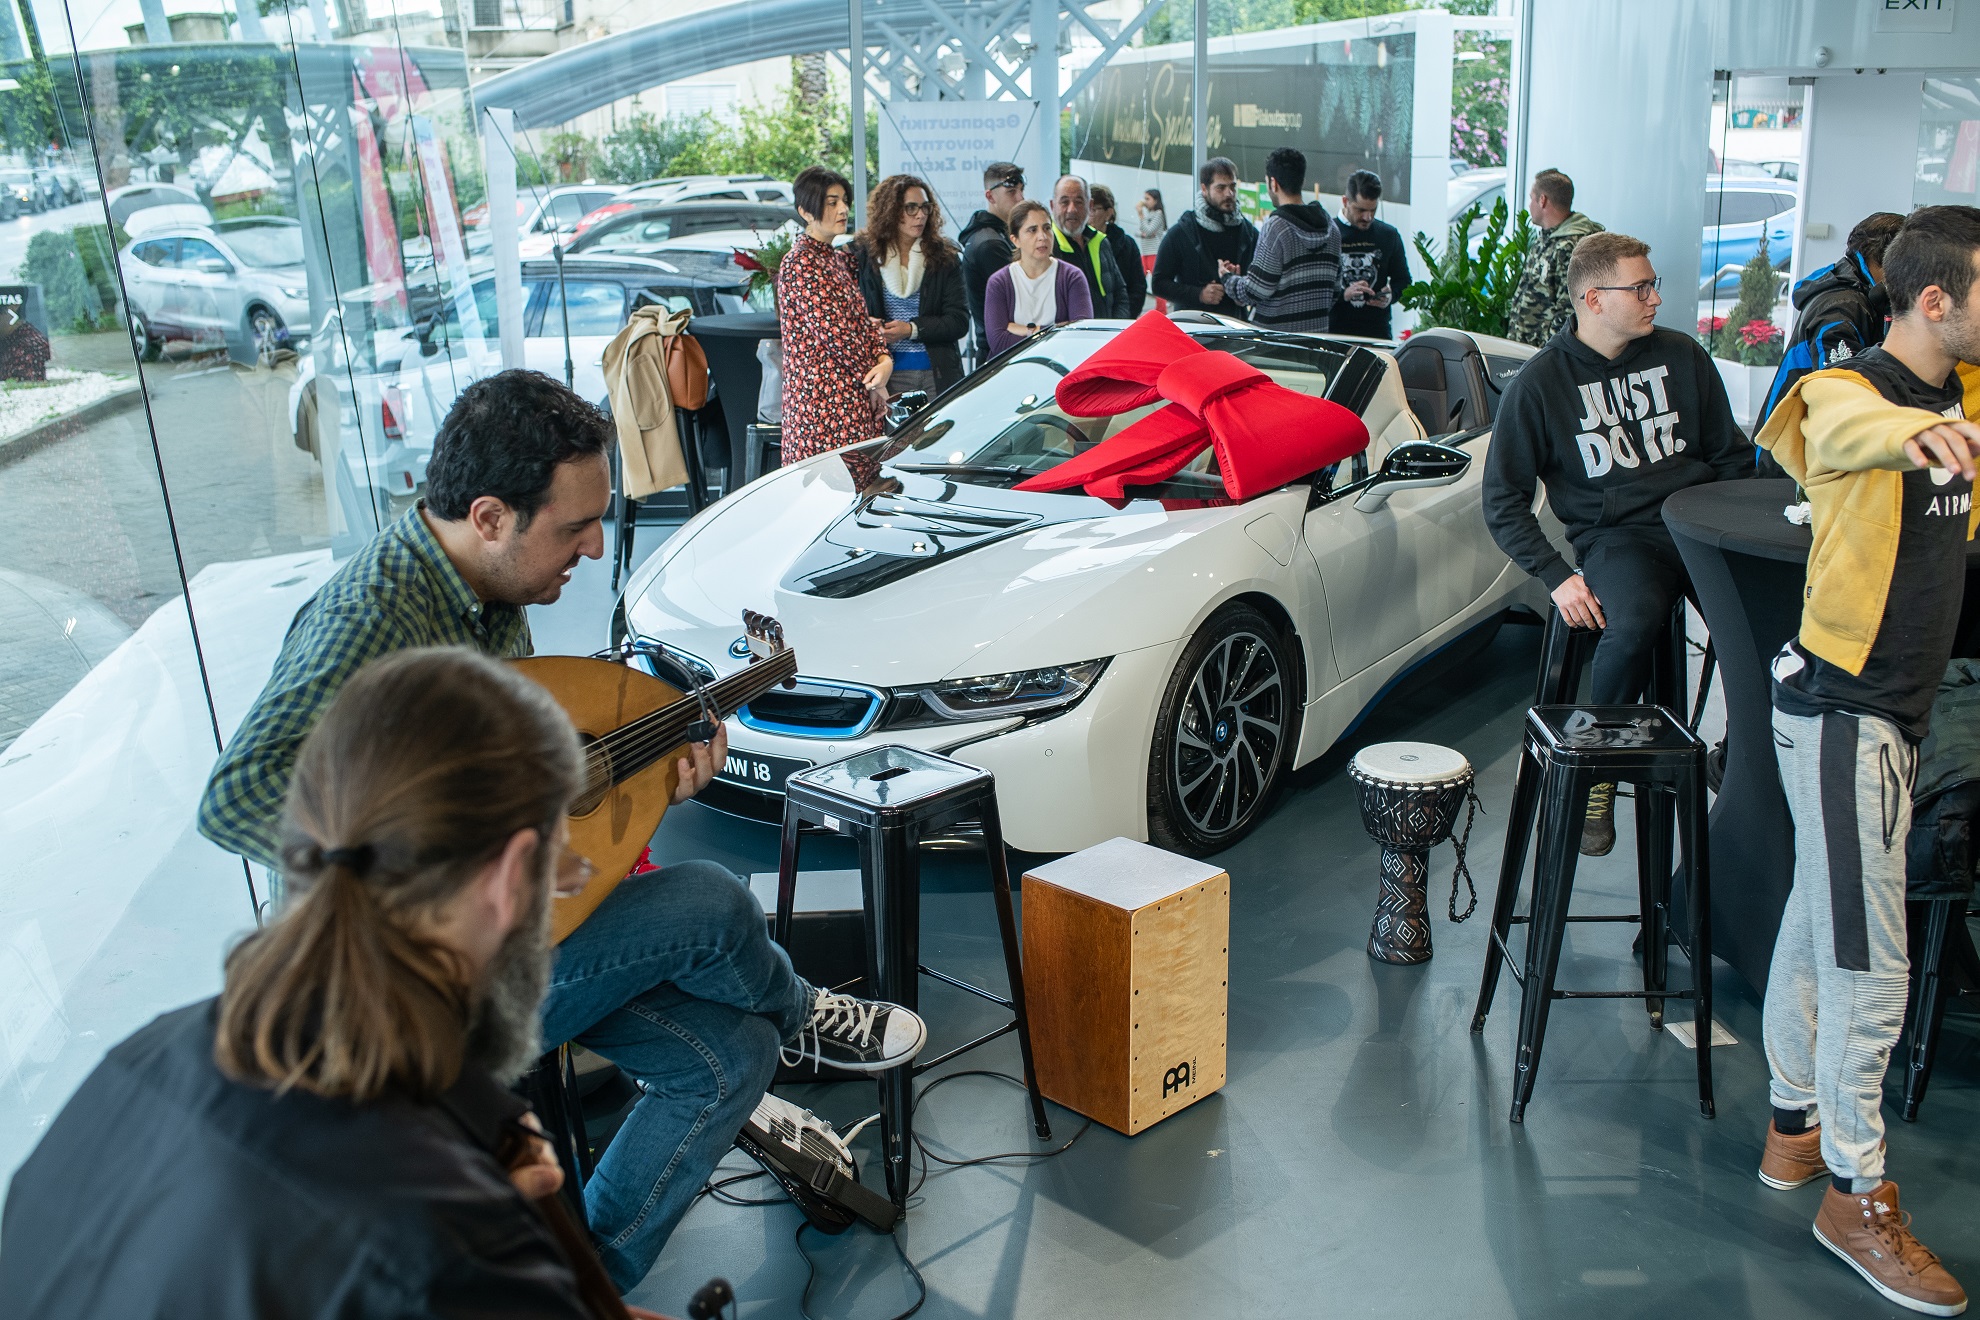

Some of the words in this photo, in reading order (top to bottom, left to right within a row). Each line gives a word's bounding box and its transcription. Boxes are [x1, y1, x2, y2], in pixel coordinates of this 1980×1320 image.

[0, 294, 23, 305] TAS
[1578, 365, 1669, 431] JUST
[1575, 425, 1640, 479] DO
[720, 756, 748, 777] MW
[752, 761, 771, 782] i8
